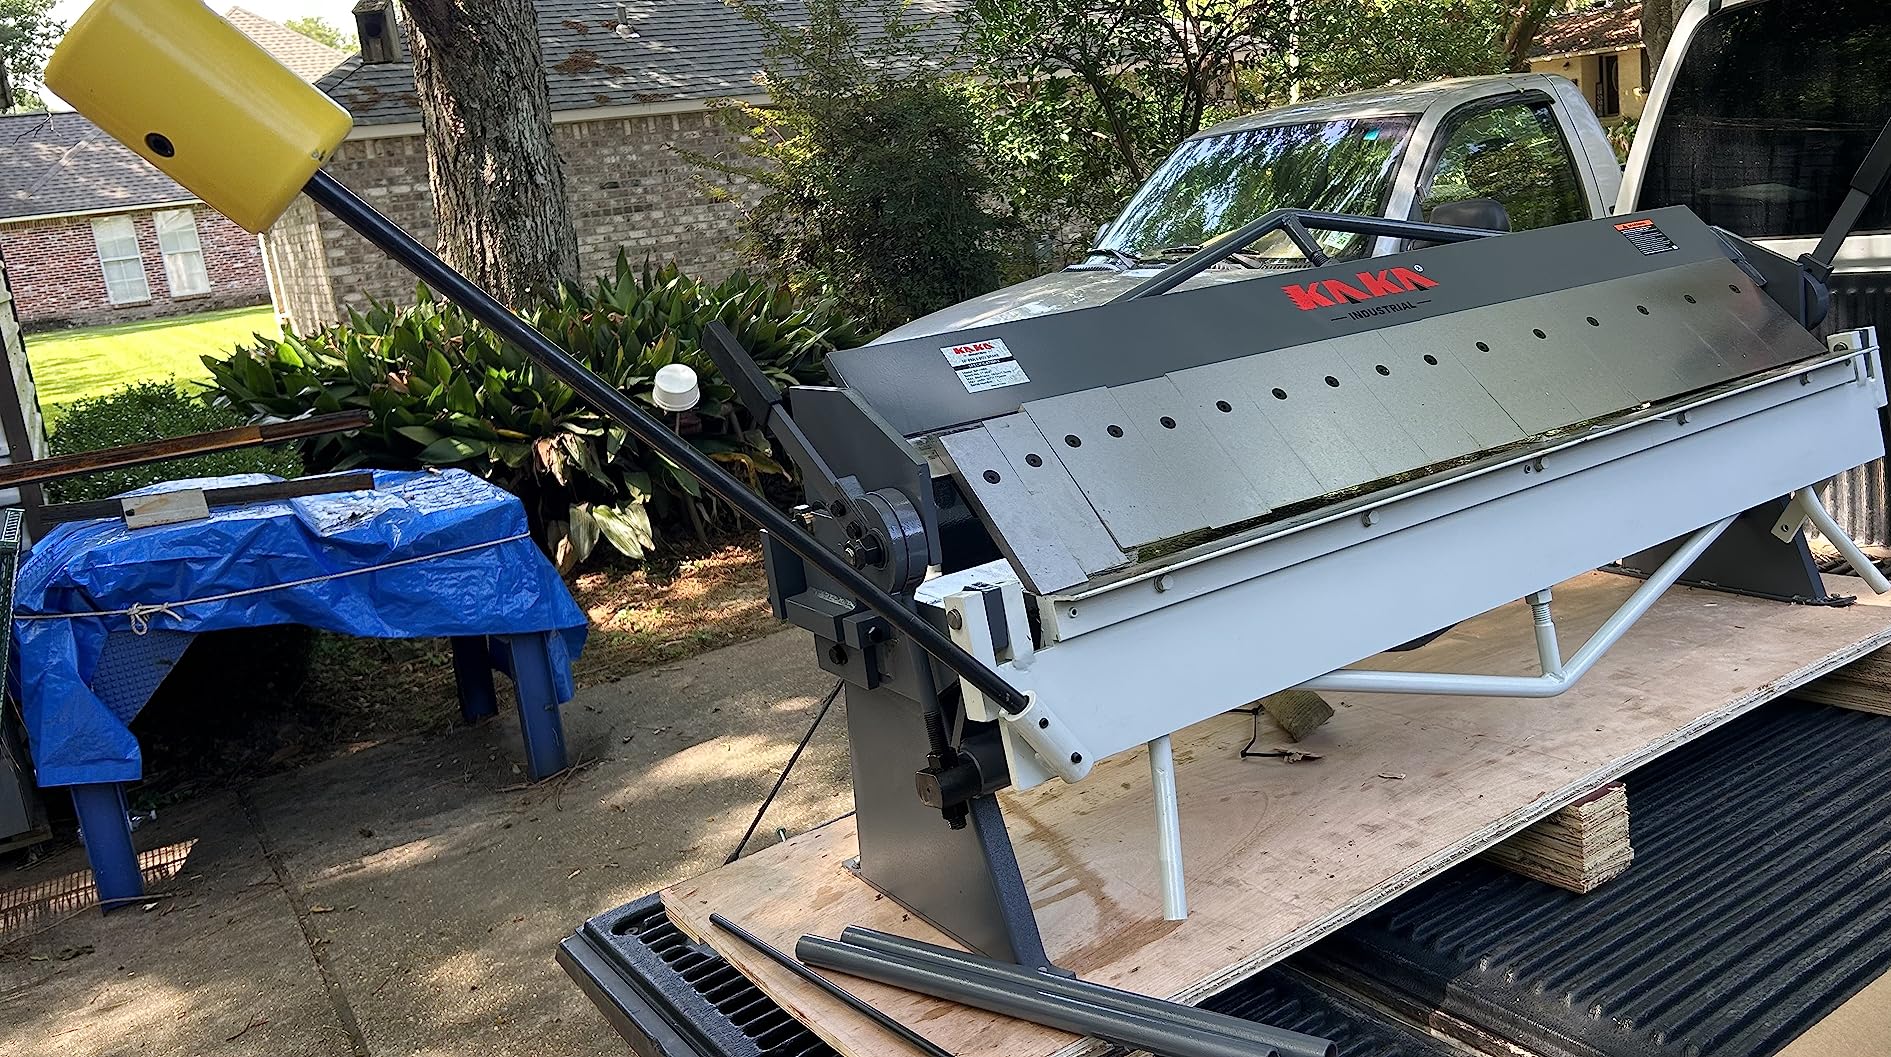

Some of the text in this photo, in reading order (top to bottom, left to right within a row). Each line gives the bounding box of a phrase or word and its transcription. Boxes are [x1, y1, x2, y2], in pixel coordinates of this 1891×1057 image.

[1280, 266, 1440, 311] KAKA
[1348, 301, 1417, 320] INDUSTRIAL
[953, 342, 995, 355] KAKA
